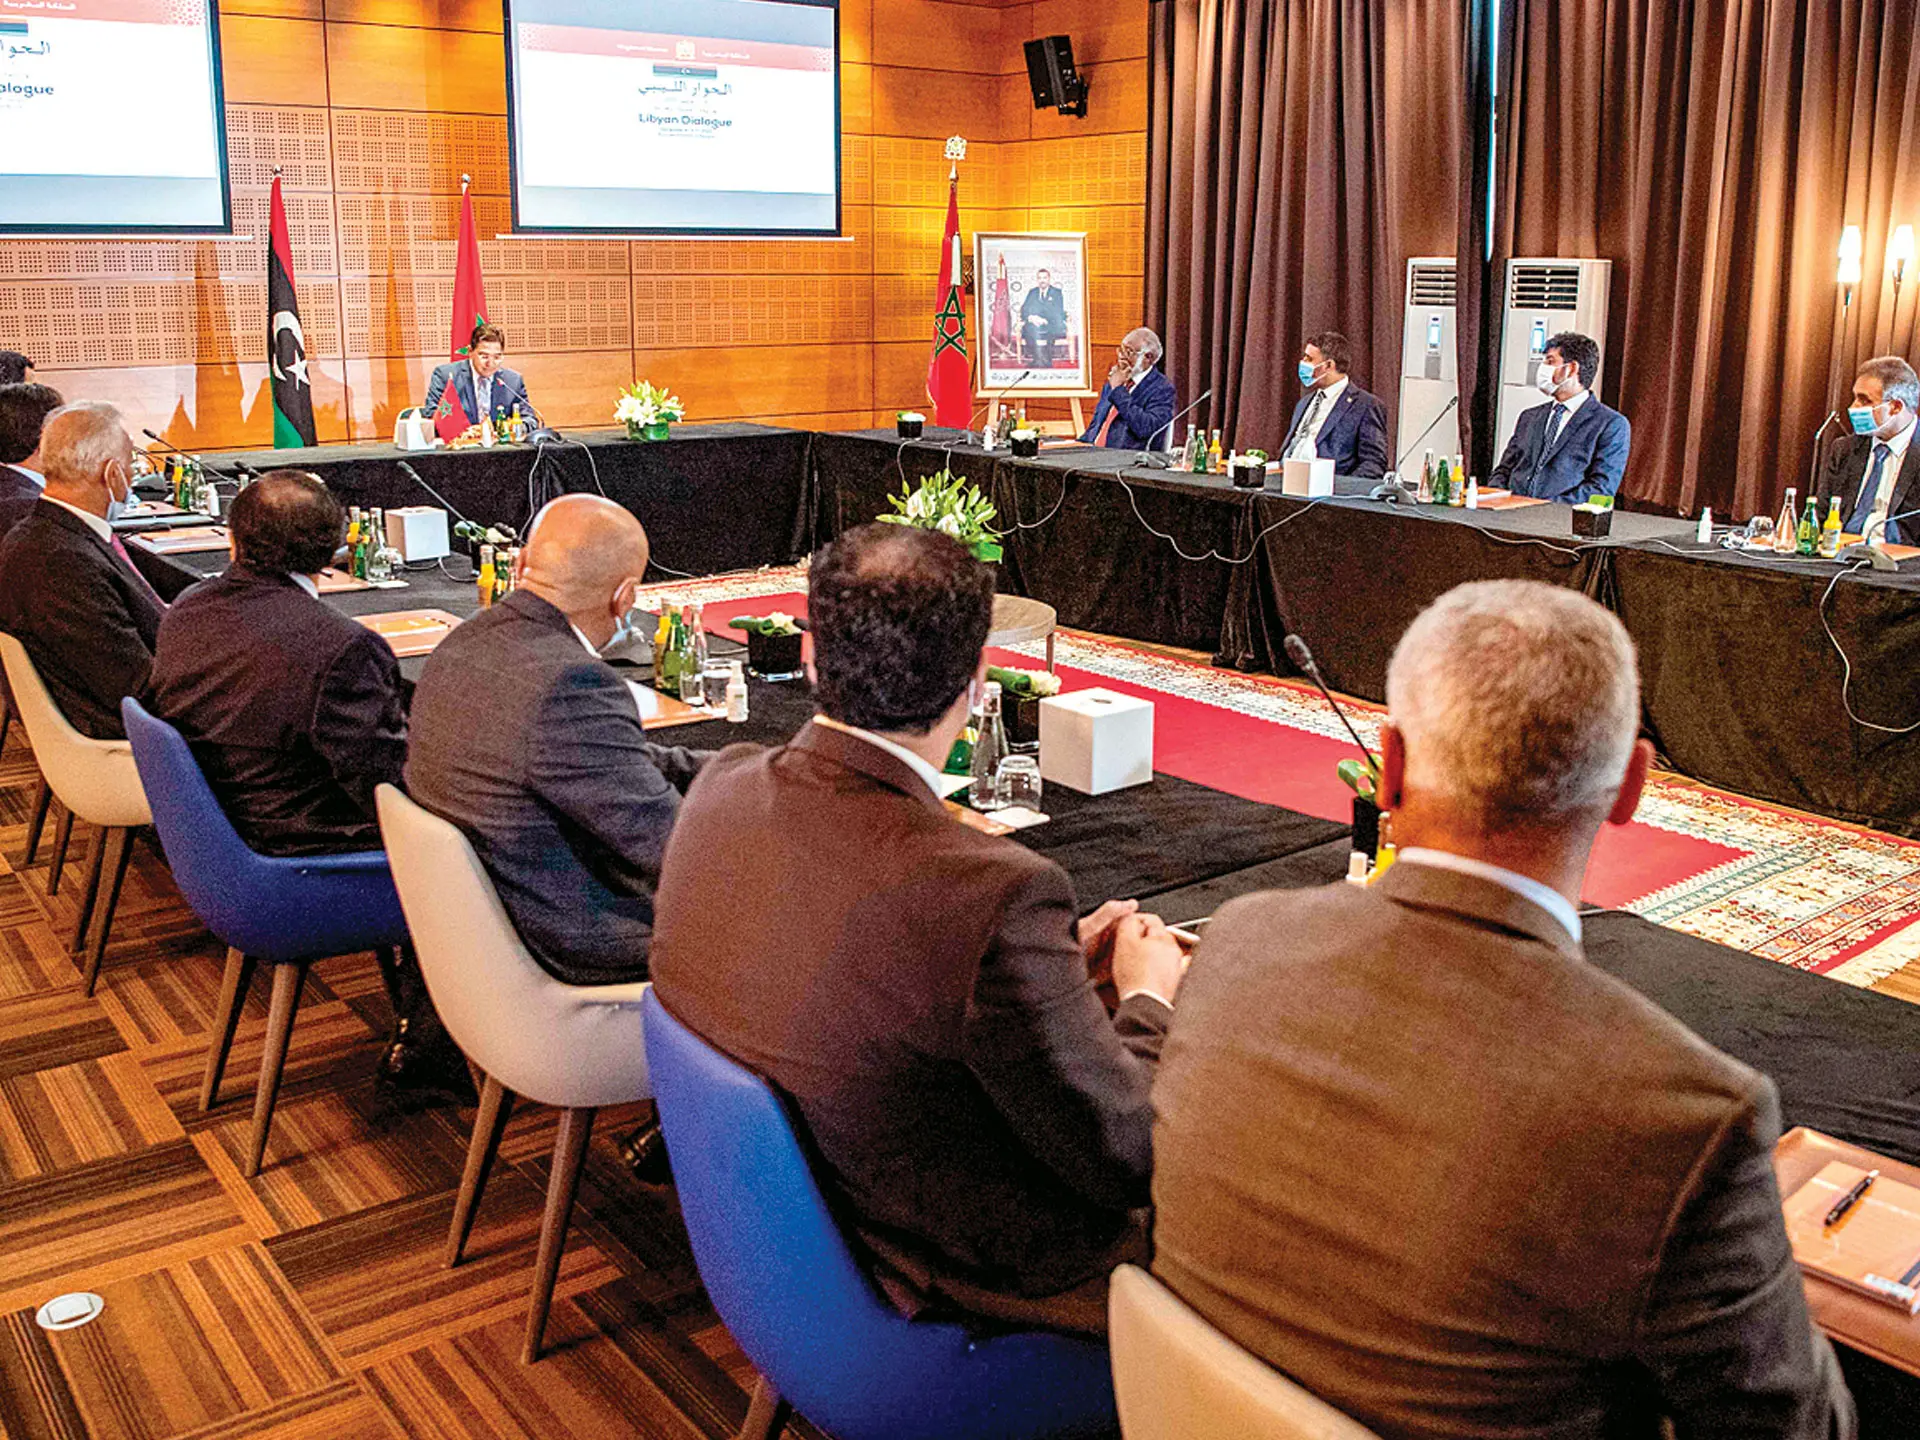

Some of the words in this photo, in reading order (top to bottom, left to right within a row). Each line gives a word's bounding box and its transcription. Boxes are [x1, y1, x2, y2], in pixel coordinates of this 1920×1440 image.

[692, 82, 733, 98] الحوار
[639, 112, 680, 125] Libyan
[681, 115, 733, 130] Dialogue
